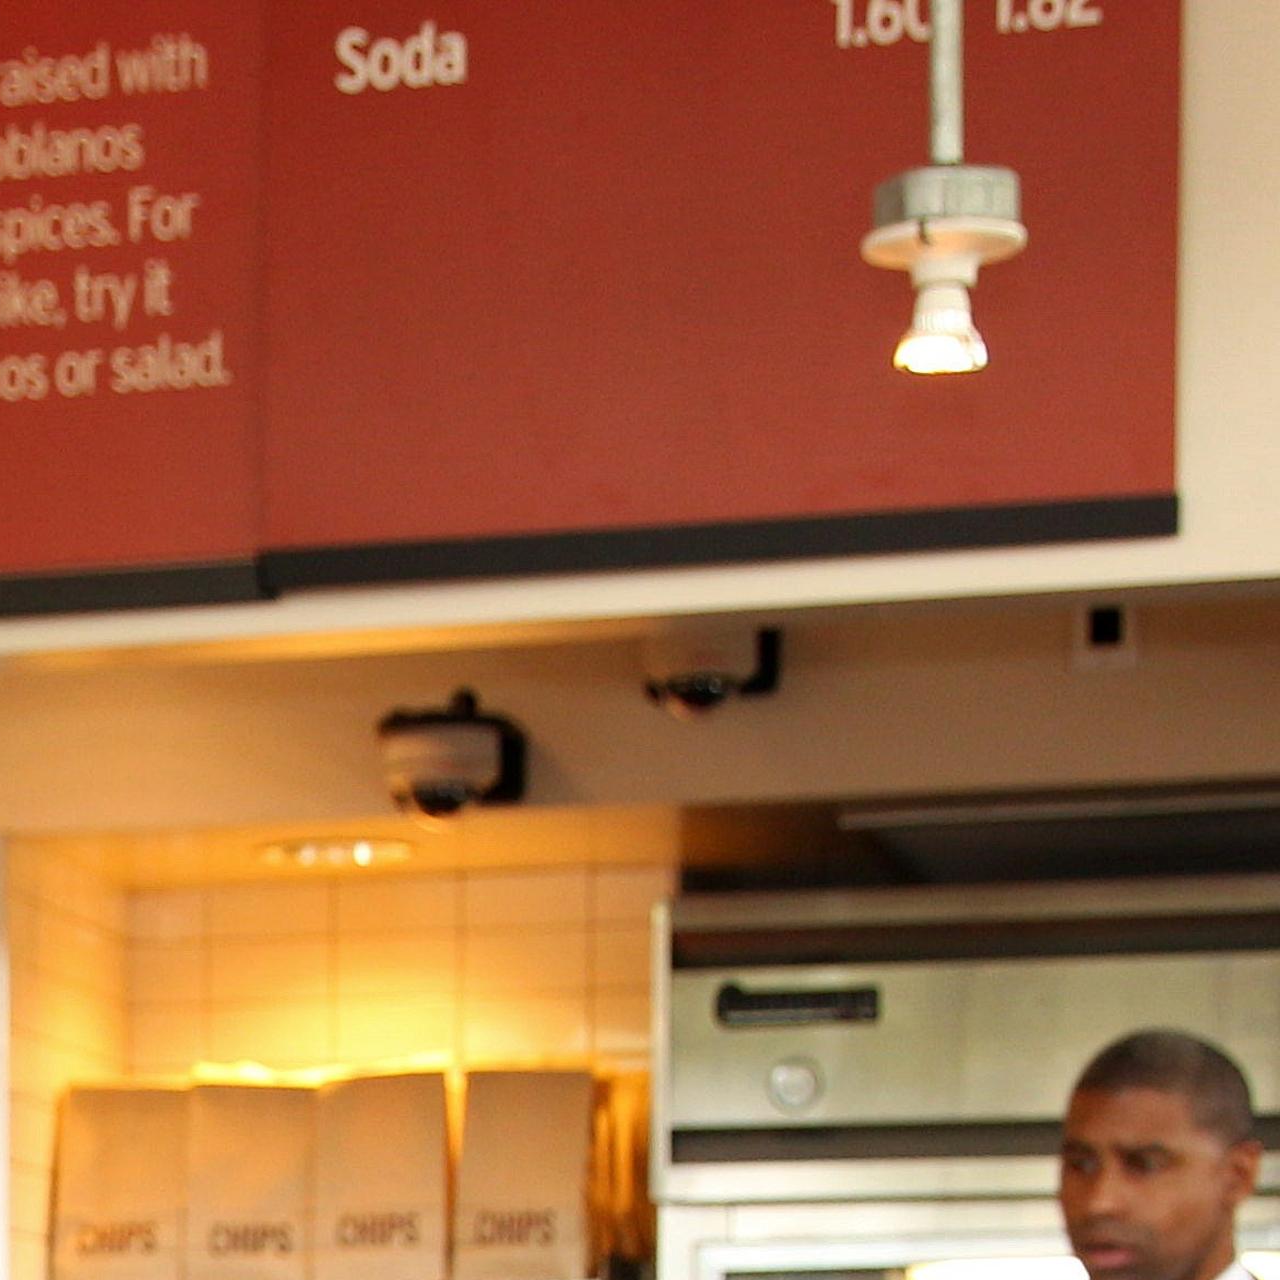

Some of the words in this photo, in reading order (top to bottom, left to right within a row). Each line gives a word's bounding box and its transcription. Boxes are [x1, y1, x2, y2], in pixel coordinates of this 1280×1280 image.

[115, 32, 209, 95] with
[335, 21, 468, 94] Soda
[127, 184, 201, 244] For
[73, 262, 139, 333] try
[54, 347, 104, 399] or
[77, 1220, 156, 1258] CHIPS
[206, 1220, 293, 1258] CHIPS
[335, 1212, 419, 1247] CHIPS
[473, 1208, 557, 1247] CHIPS
